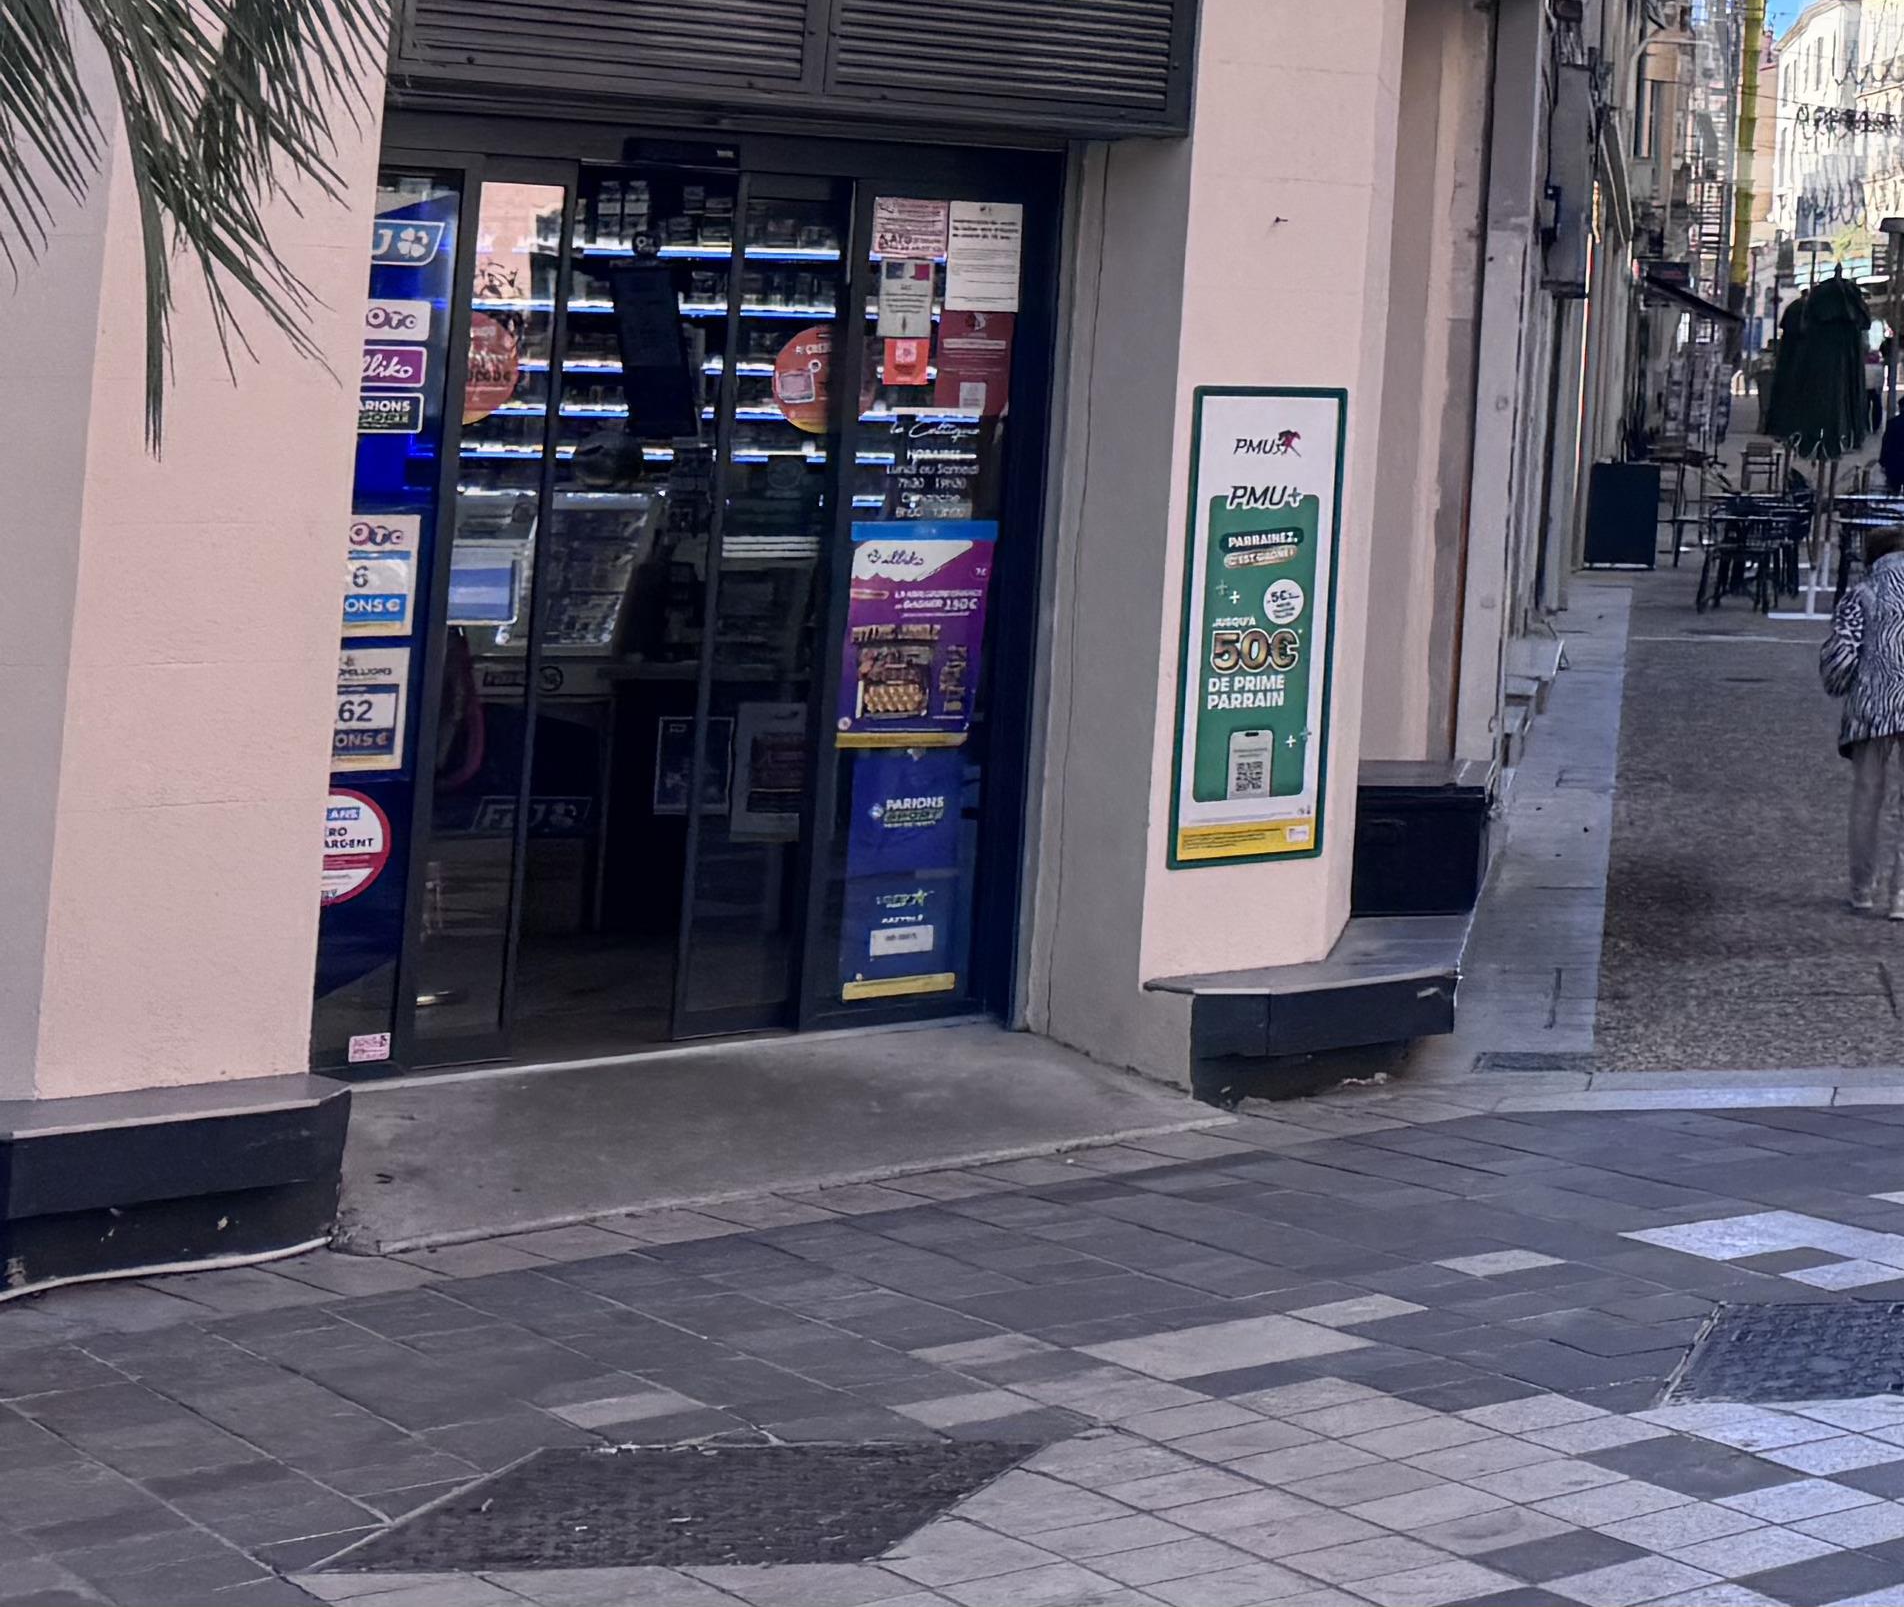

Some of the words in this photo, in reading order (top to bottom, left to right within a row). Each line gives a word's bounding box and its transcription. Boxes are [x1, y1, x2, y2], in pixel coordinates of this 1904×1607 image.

[1233, 437, 1277, 456] PMU
[1207, 676, 1231, 693] DE
[1233, 675, 1286, 692] PRIME
[1207, 691, 1285, 711] PARRAIN
